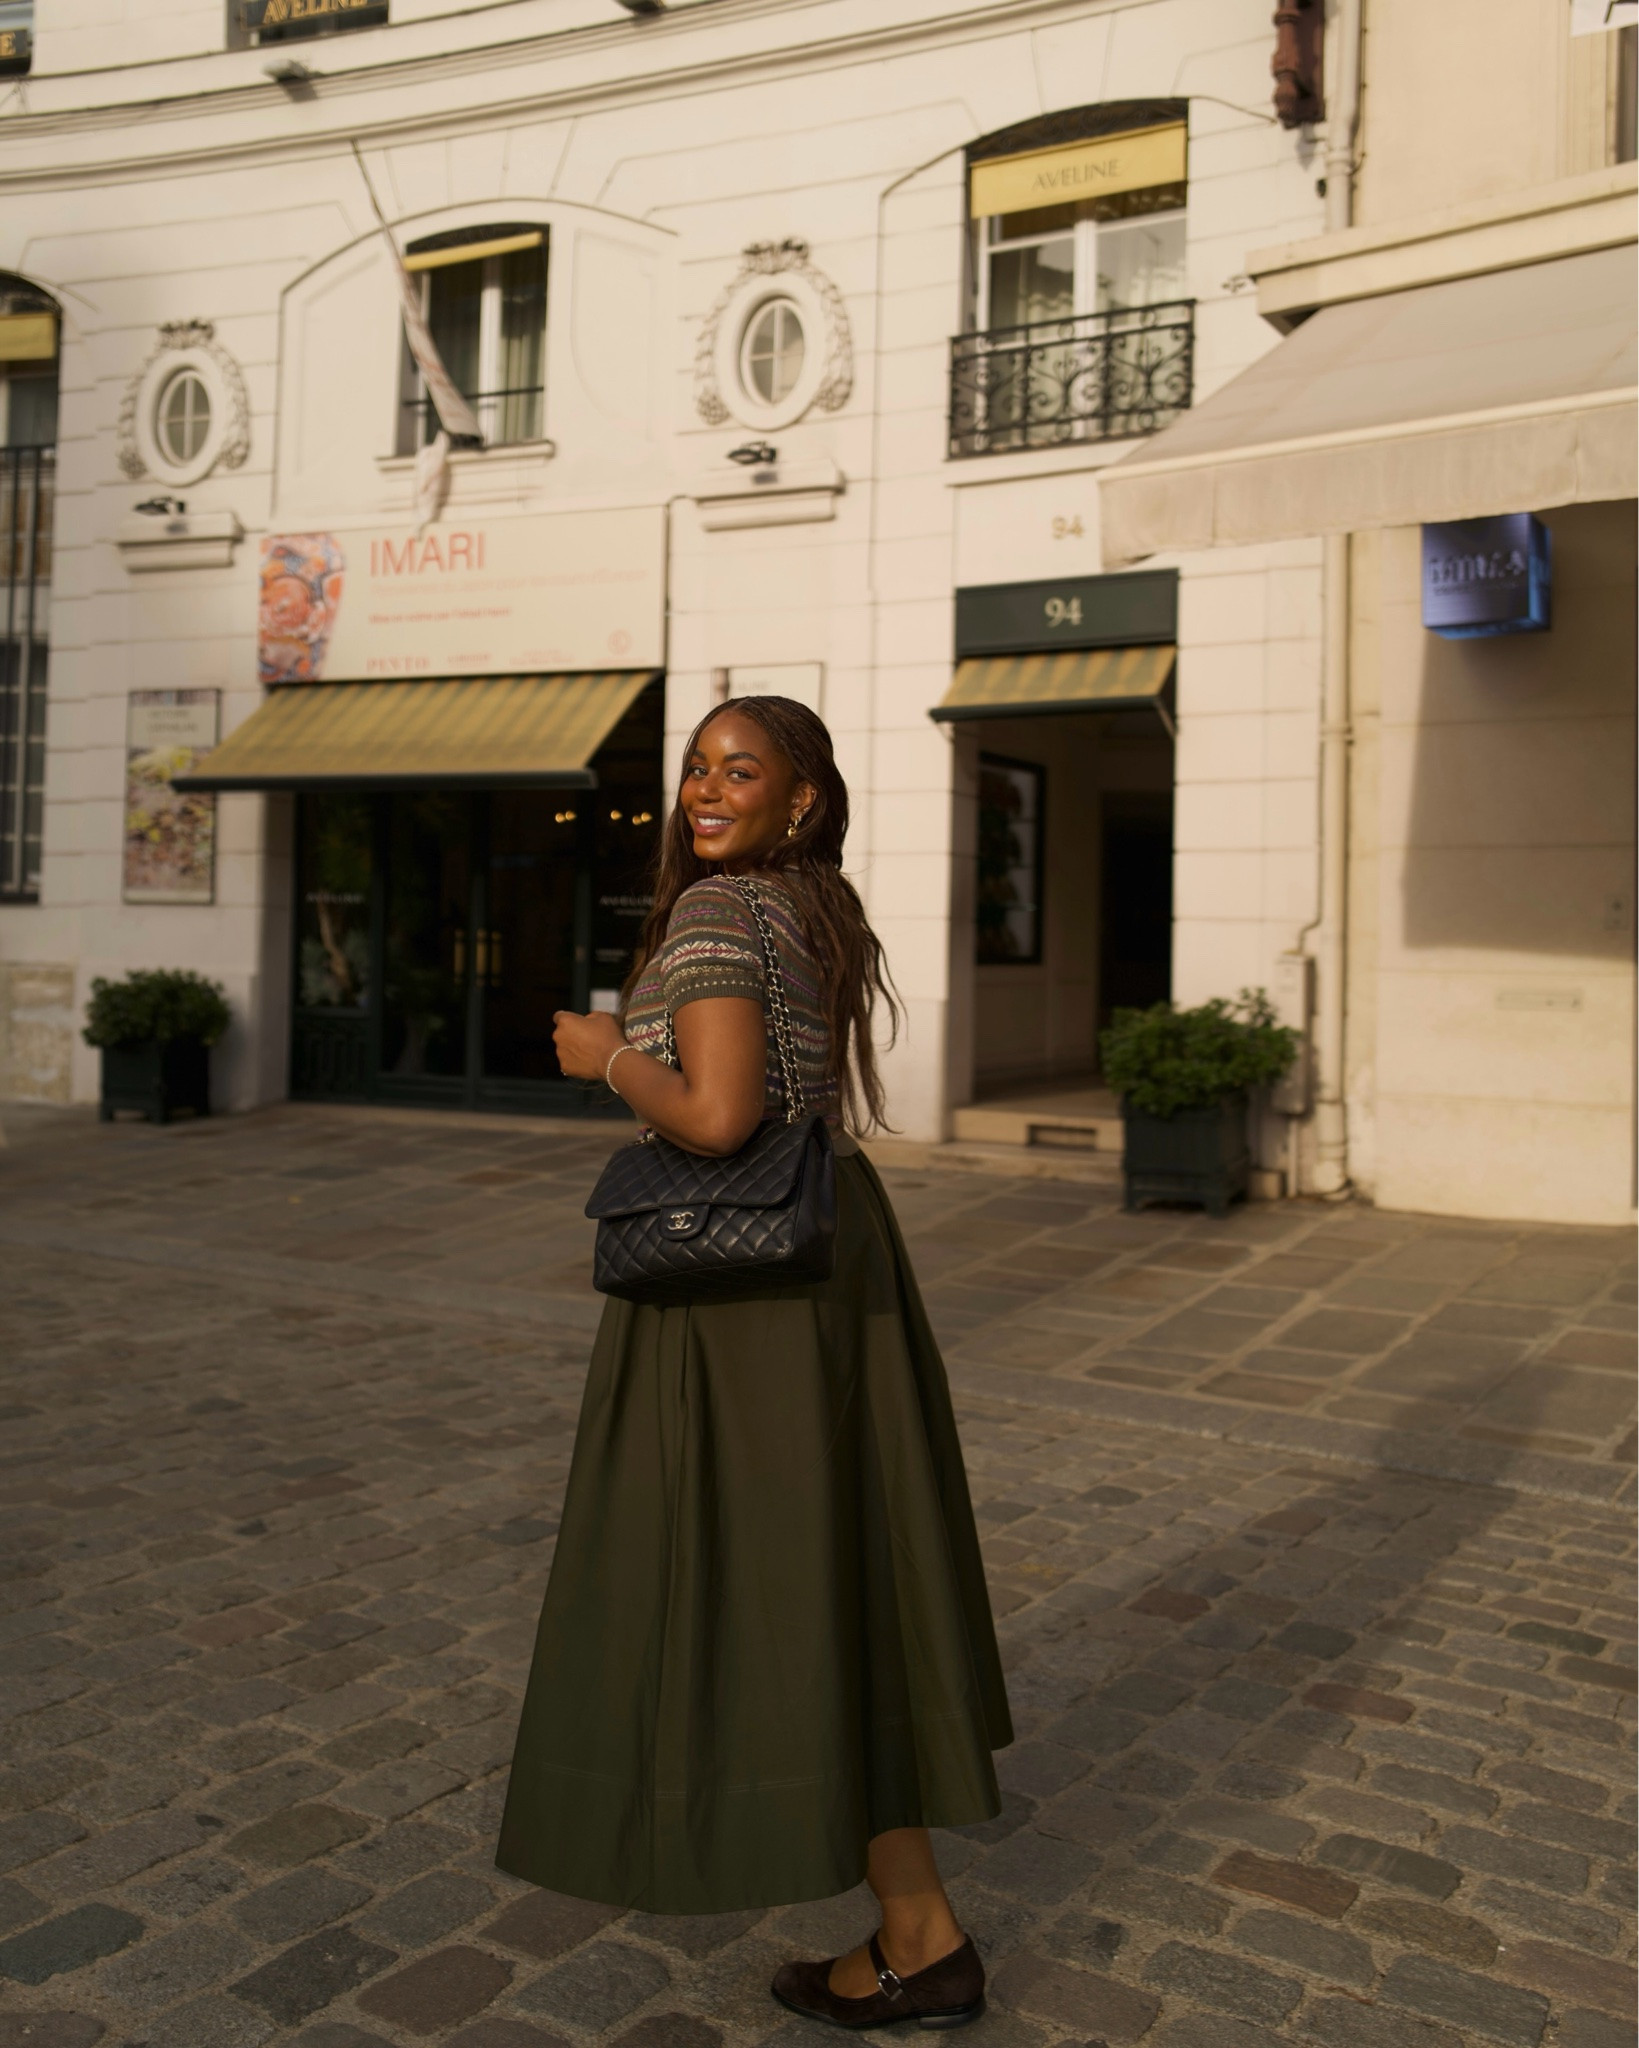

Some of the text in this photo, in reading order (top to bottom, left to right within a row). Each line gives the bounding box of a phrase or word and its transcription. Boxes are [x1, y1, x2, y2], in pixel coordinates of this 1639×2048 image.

[262, 0, 369, 24] AVELI
[1032, 159, 1122, 191] AVELINE
[370, 531, 486, 577] IMARI
[1044, 597, 1083, 627] 94
